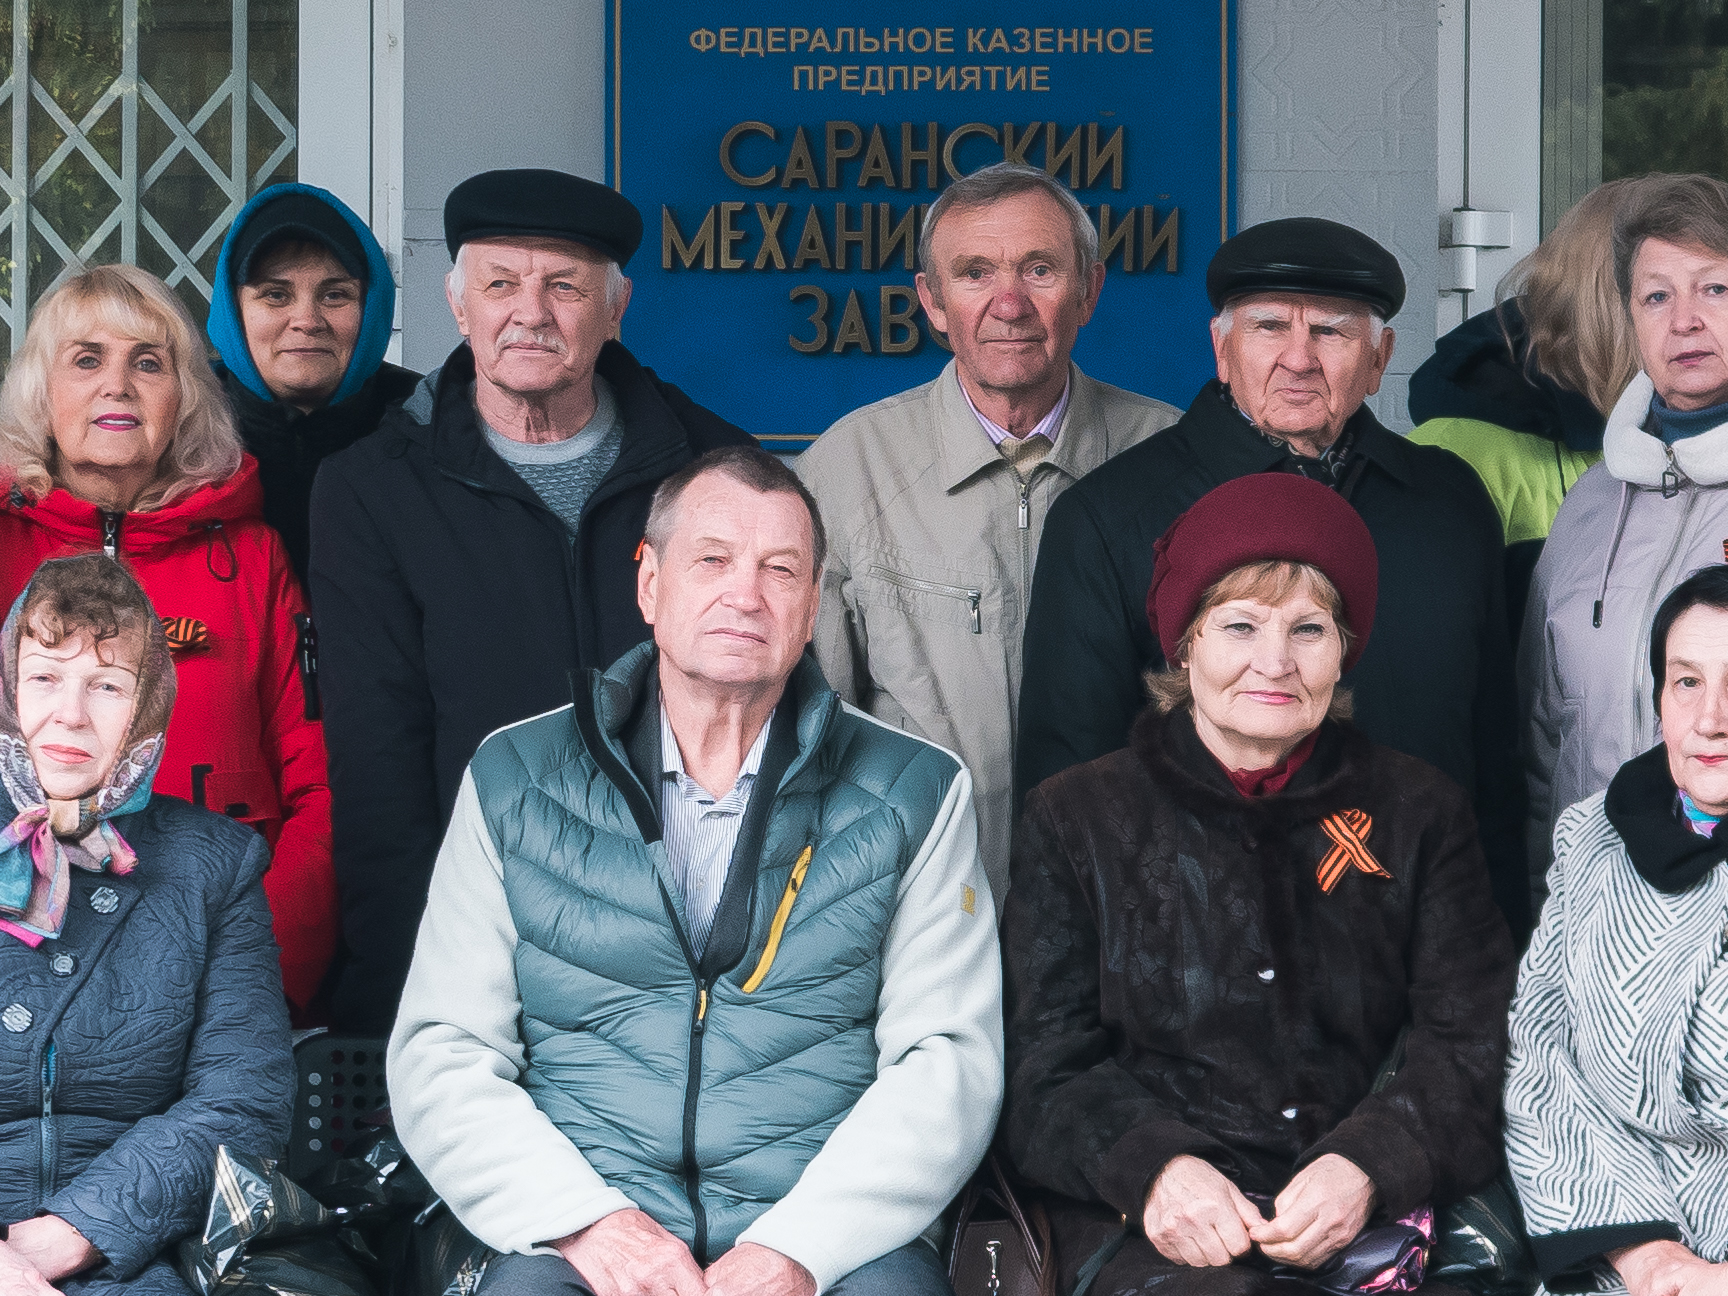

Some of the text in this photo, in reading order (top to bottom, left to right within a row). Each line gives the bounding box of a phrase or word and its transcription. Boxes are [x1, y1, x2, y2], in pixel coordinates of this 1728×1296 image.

[689, 26, 1154, 57] ФЕДЕРАЛЬНОЕ КАЗЕННОЕ
[792, 64, 1051, 96] ПРЕДПРИЯТИЕ
[661, 194, 1179, 272] МЕХАНИИЙ
[788, 284, 956, 353] ЗАВ
